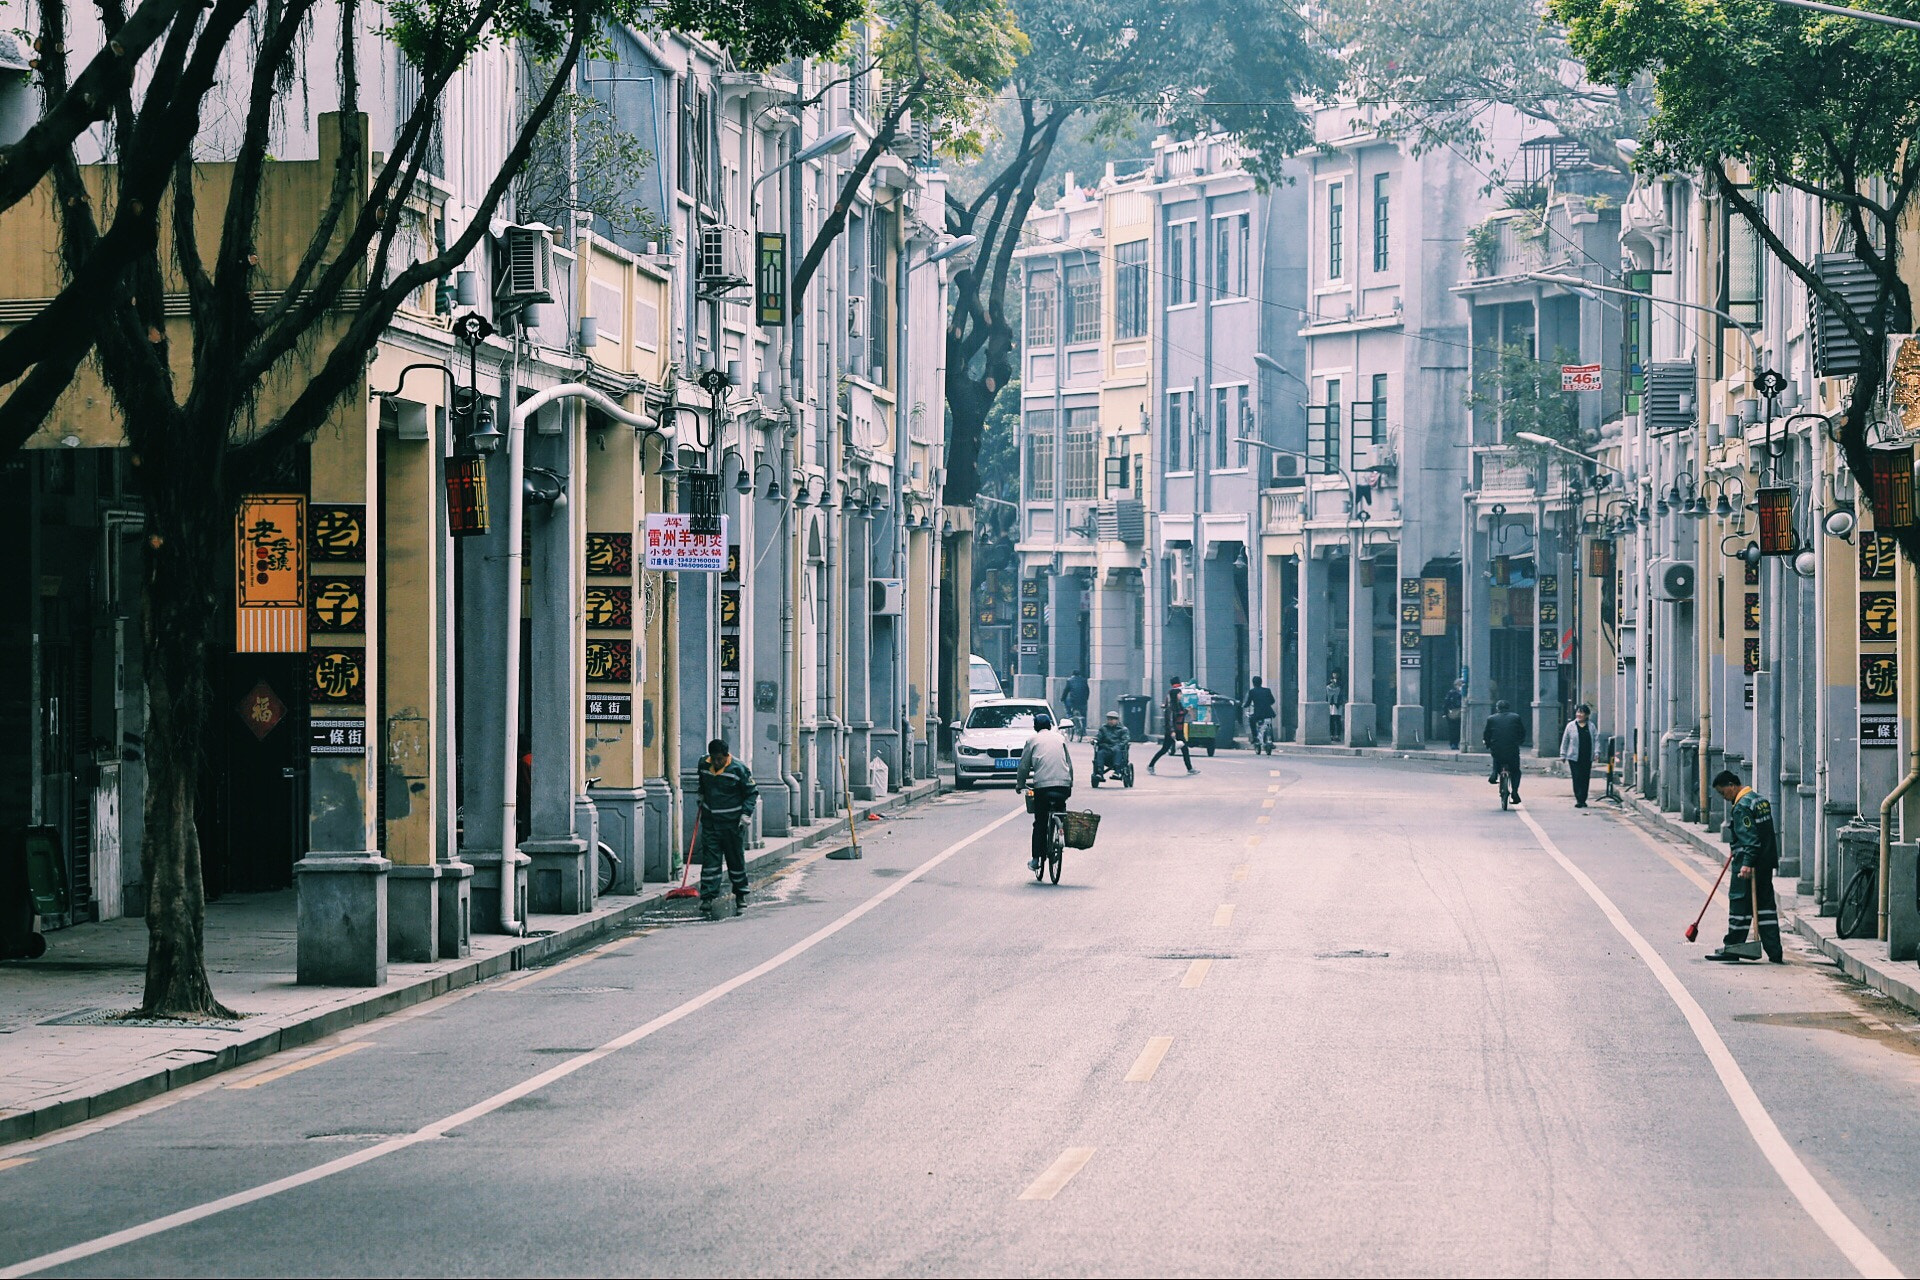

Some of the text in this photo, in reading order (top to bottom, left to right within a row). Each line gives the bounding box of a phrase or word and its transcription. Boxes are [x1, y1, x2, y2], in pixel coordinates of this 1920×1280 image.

[1572, 373, 1592, 384] 46
[648, 529, 722, 547] 雷州羊狗煲
[316, 511, 359, 695] 老字號
[251, 697, 273, 722] 福
[313, 729, 362, 745] 一條街
